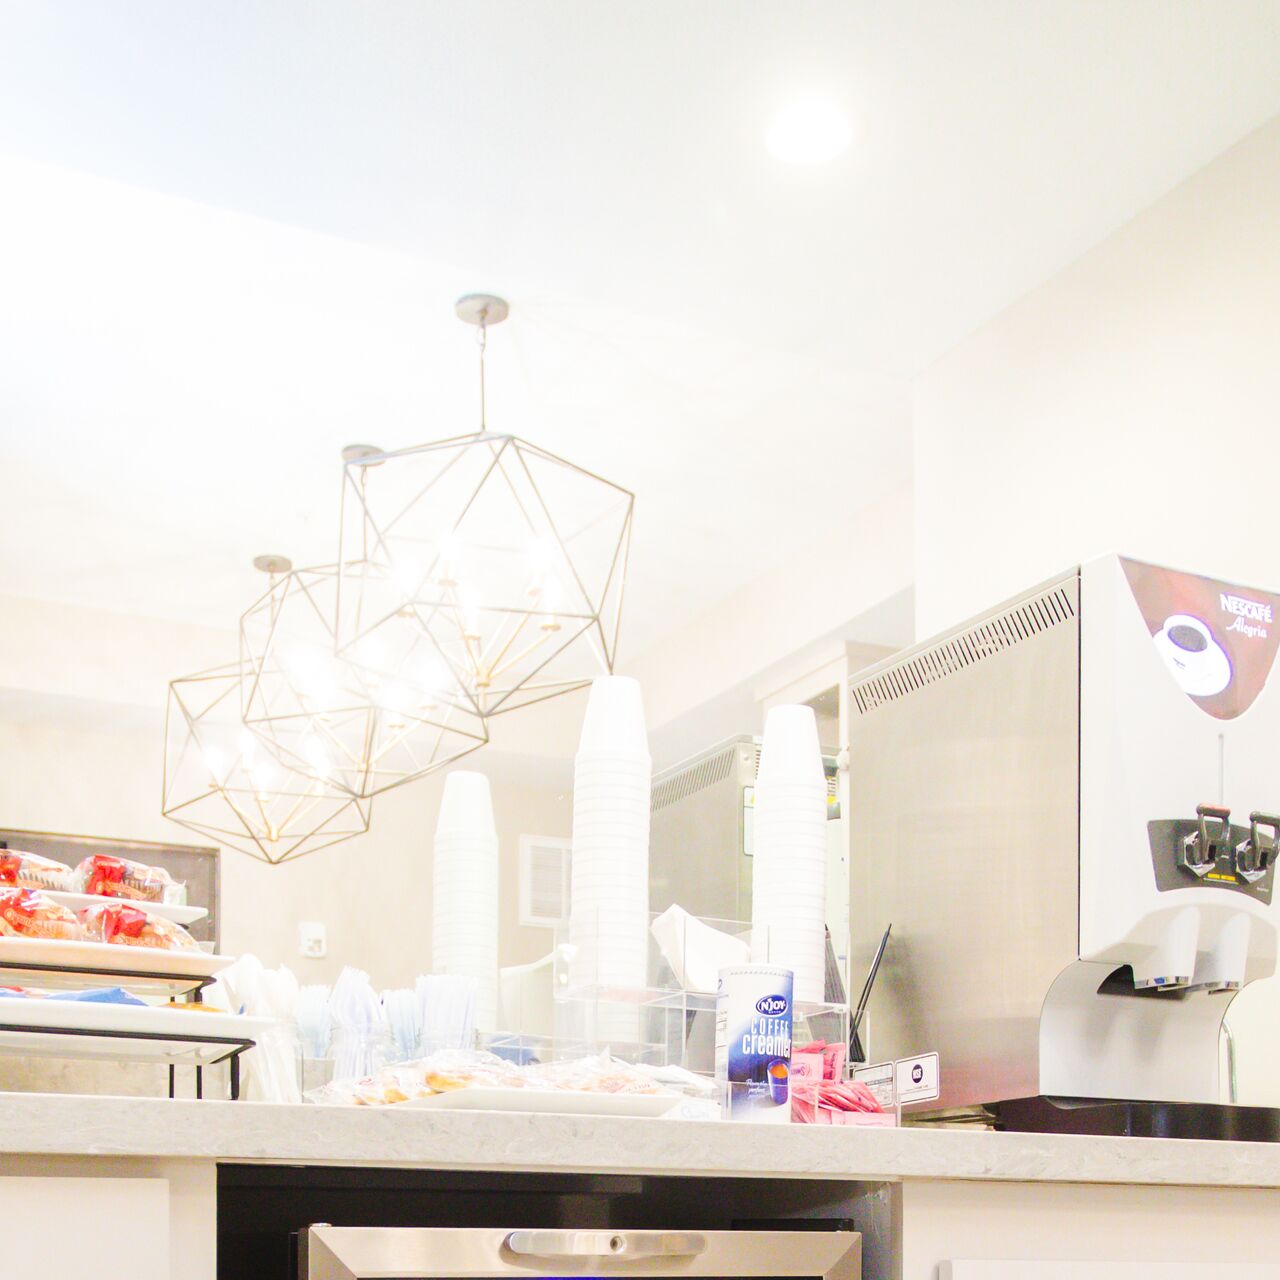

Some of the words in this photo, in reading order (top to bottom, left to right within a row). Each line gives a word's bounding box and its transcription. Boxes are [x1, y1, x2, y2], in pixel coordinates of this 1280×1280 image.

[1220, 593, 1272, 623] NESCAFÉ
[1226, 616, 1267, 638] Alegria
[751, 1018, 789, 1037] COFFEE
